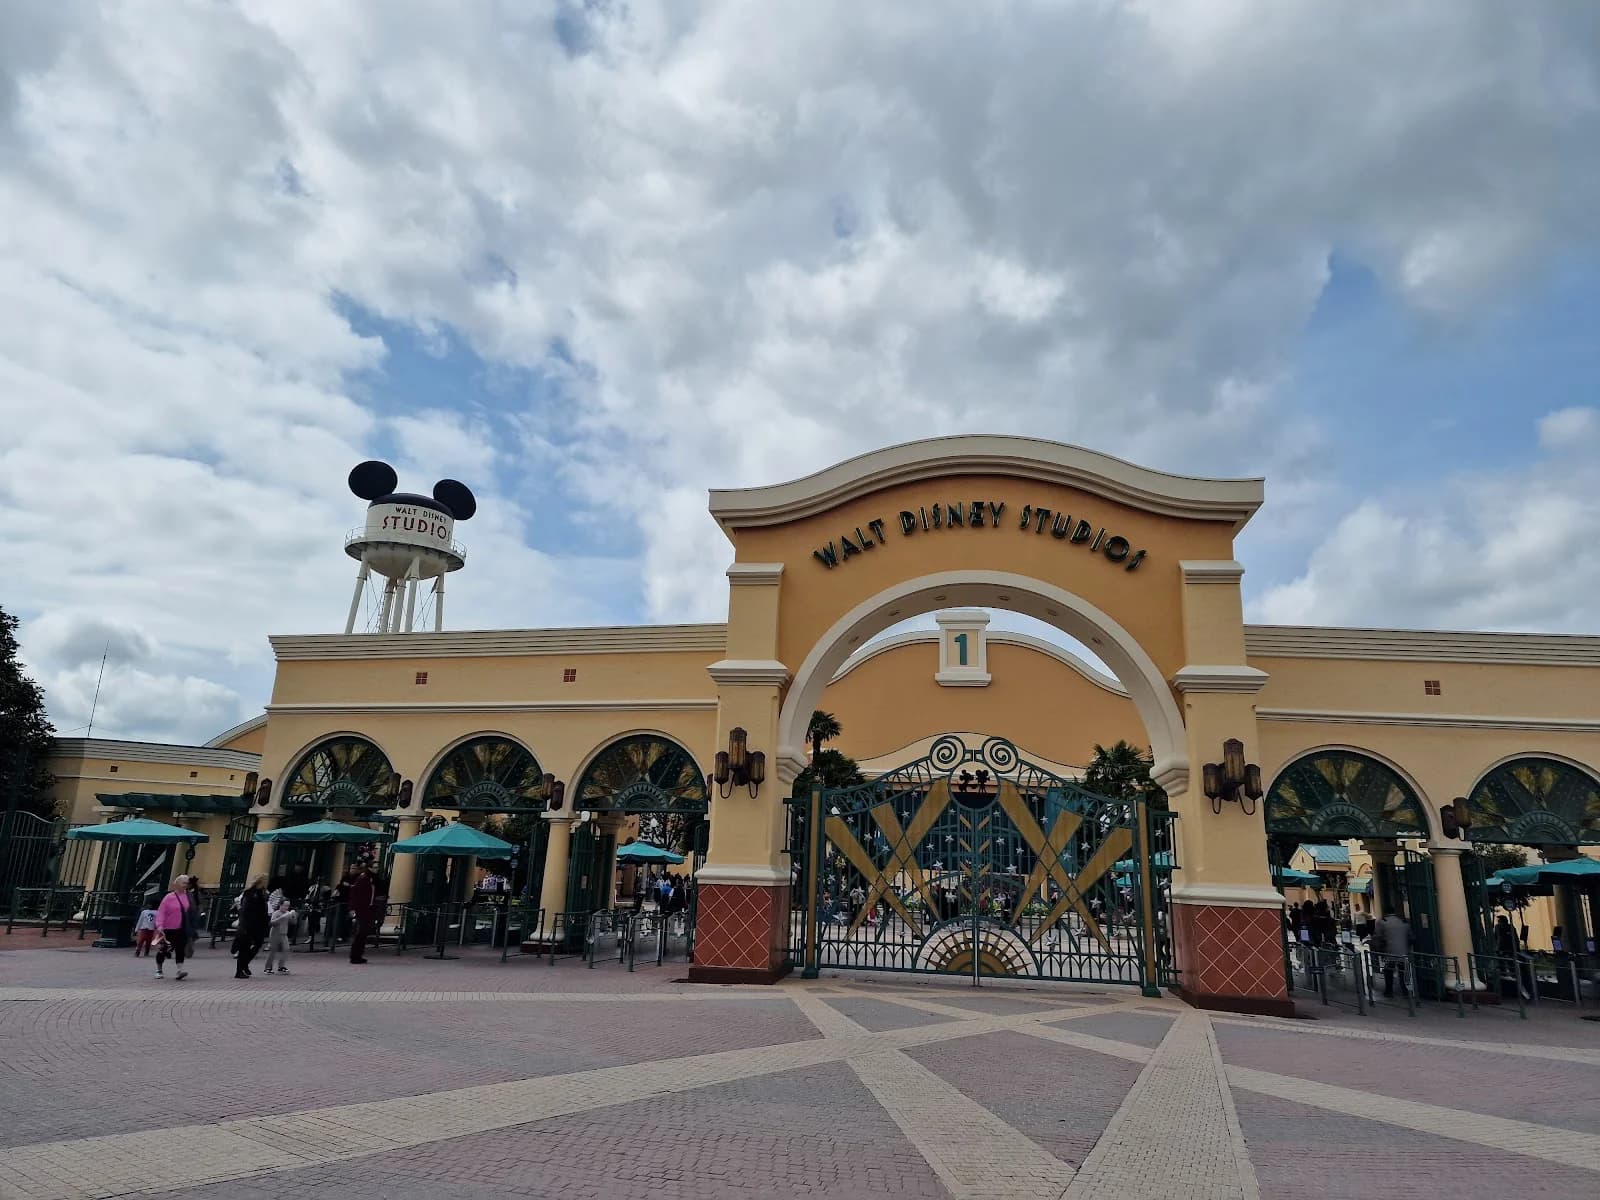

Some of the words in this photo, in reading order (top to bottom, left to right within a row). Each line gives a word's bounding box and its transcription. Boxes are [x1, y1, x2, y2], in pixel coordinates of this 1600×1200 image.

[382, 516, 451, 541] STUDIOS
[395, 506, 418, 515] WALT
[423, 510, 447, 523] DISNEY
[813, 518, 886, 569] WALT
[899, 501, 1005, 535] DISNEY
[1019, 504, 1147, 571] STUDIOS
[954, 633, 968, 666] 1
